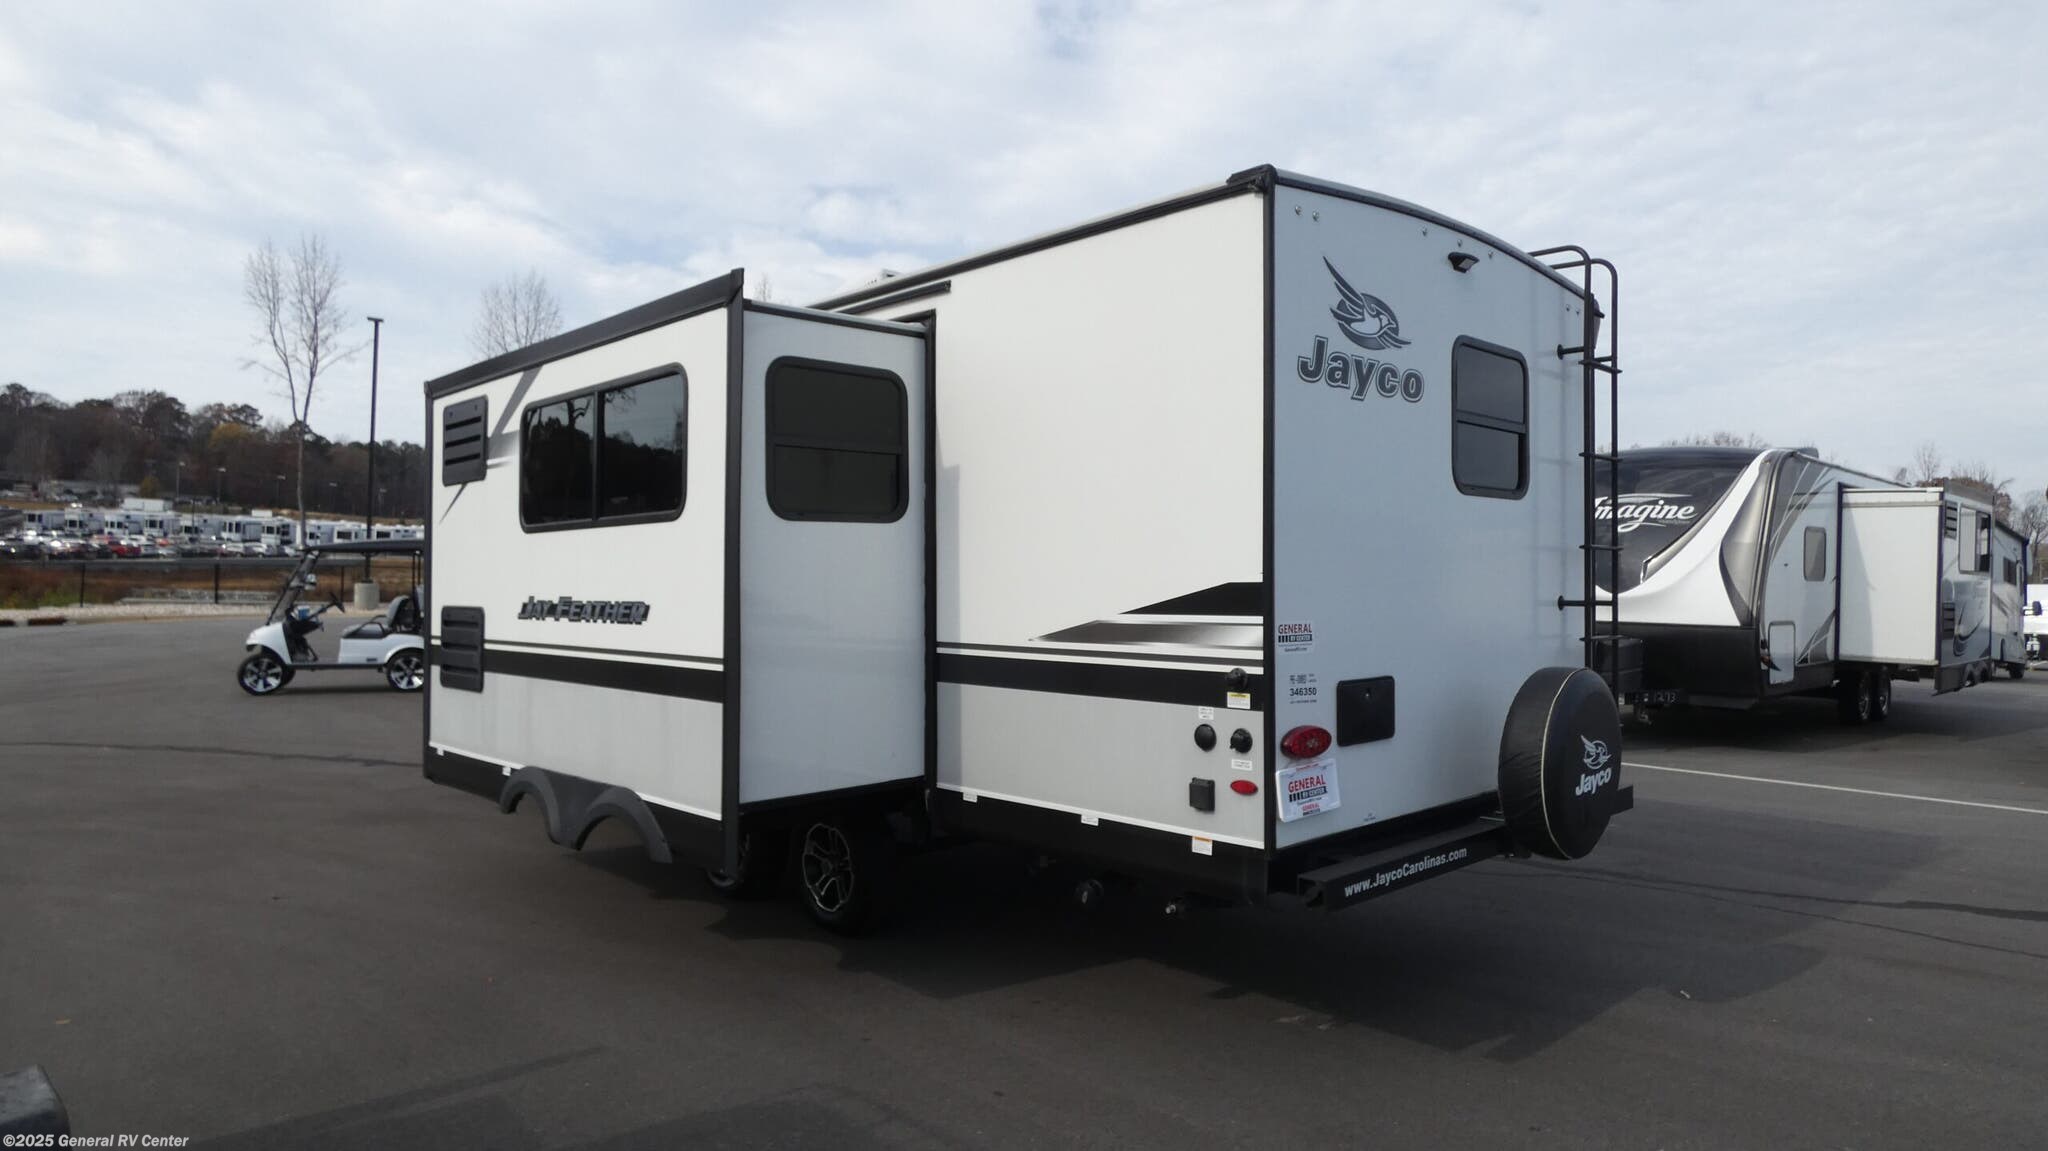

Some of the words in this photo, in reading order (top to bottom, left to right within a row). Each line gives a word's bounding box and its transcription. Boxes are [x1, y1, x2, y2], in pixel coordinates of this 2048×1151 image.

[1297, 335, 1425, 403] Jayco
[554, 596, 650, 625] FEATHER
[1278, 624, 1313, 635] GENERAL
[1289, 687, 1317, 697] 346350
[1288, 774, 1327, 793] GENERAL
[1575, 767, 1612, 796] Jayco
[1344, 847, 1468, 897] www.JaycoCarolinas.com
